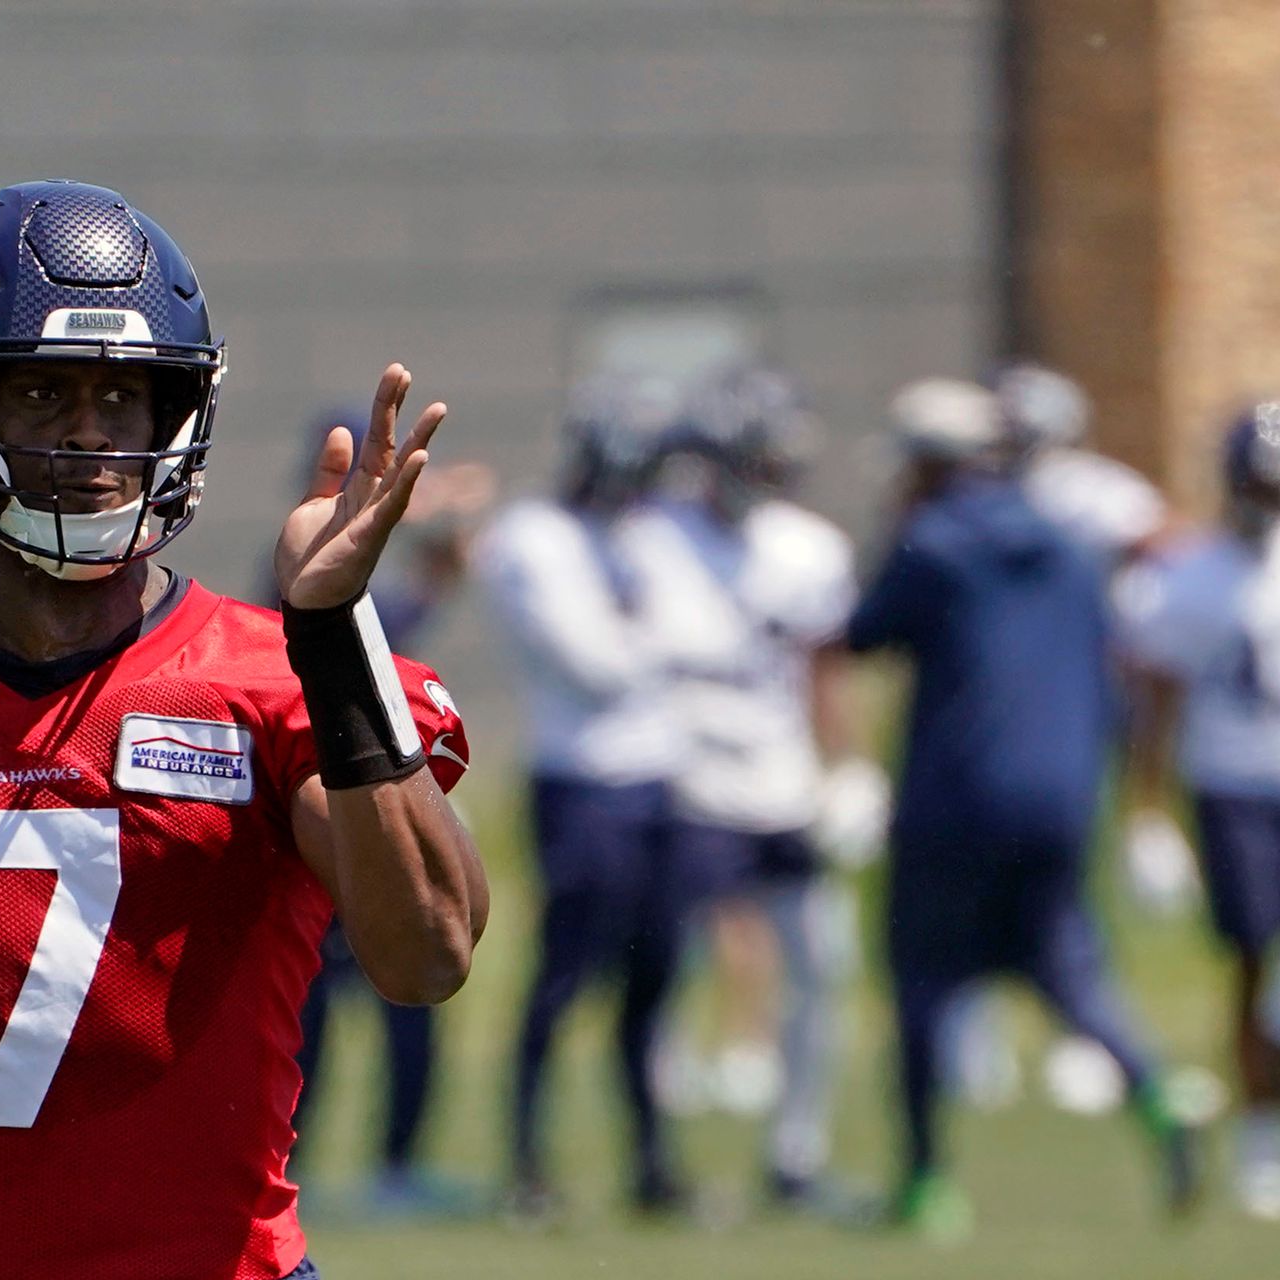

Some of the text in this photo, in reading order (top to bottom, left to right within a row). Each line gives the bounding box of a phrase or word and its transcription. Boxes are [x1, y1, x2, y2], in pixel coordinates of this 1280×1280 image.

[68, 312, 127, 329] SEAHAWKS
[131, 746, 243, 769] AMERICAN FAMILY
[140, 758, 233, 777] INSURANCE
